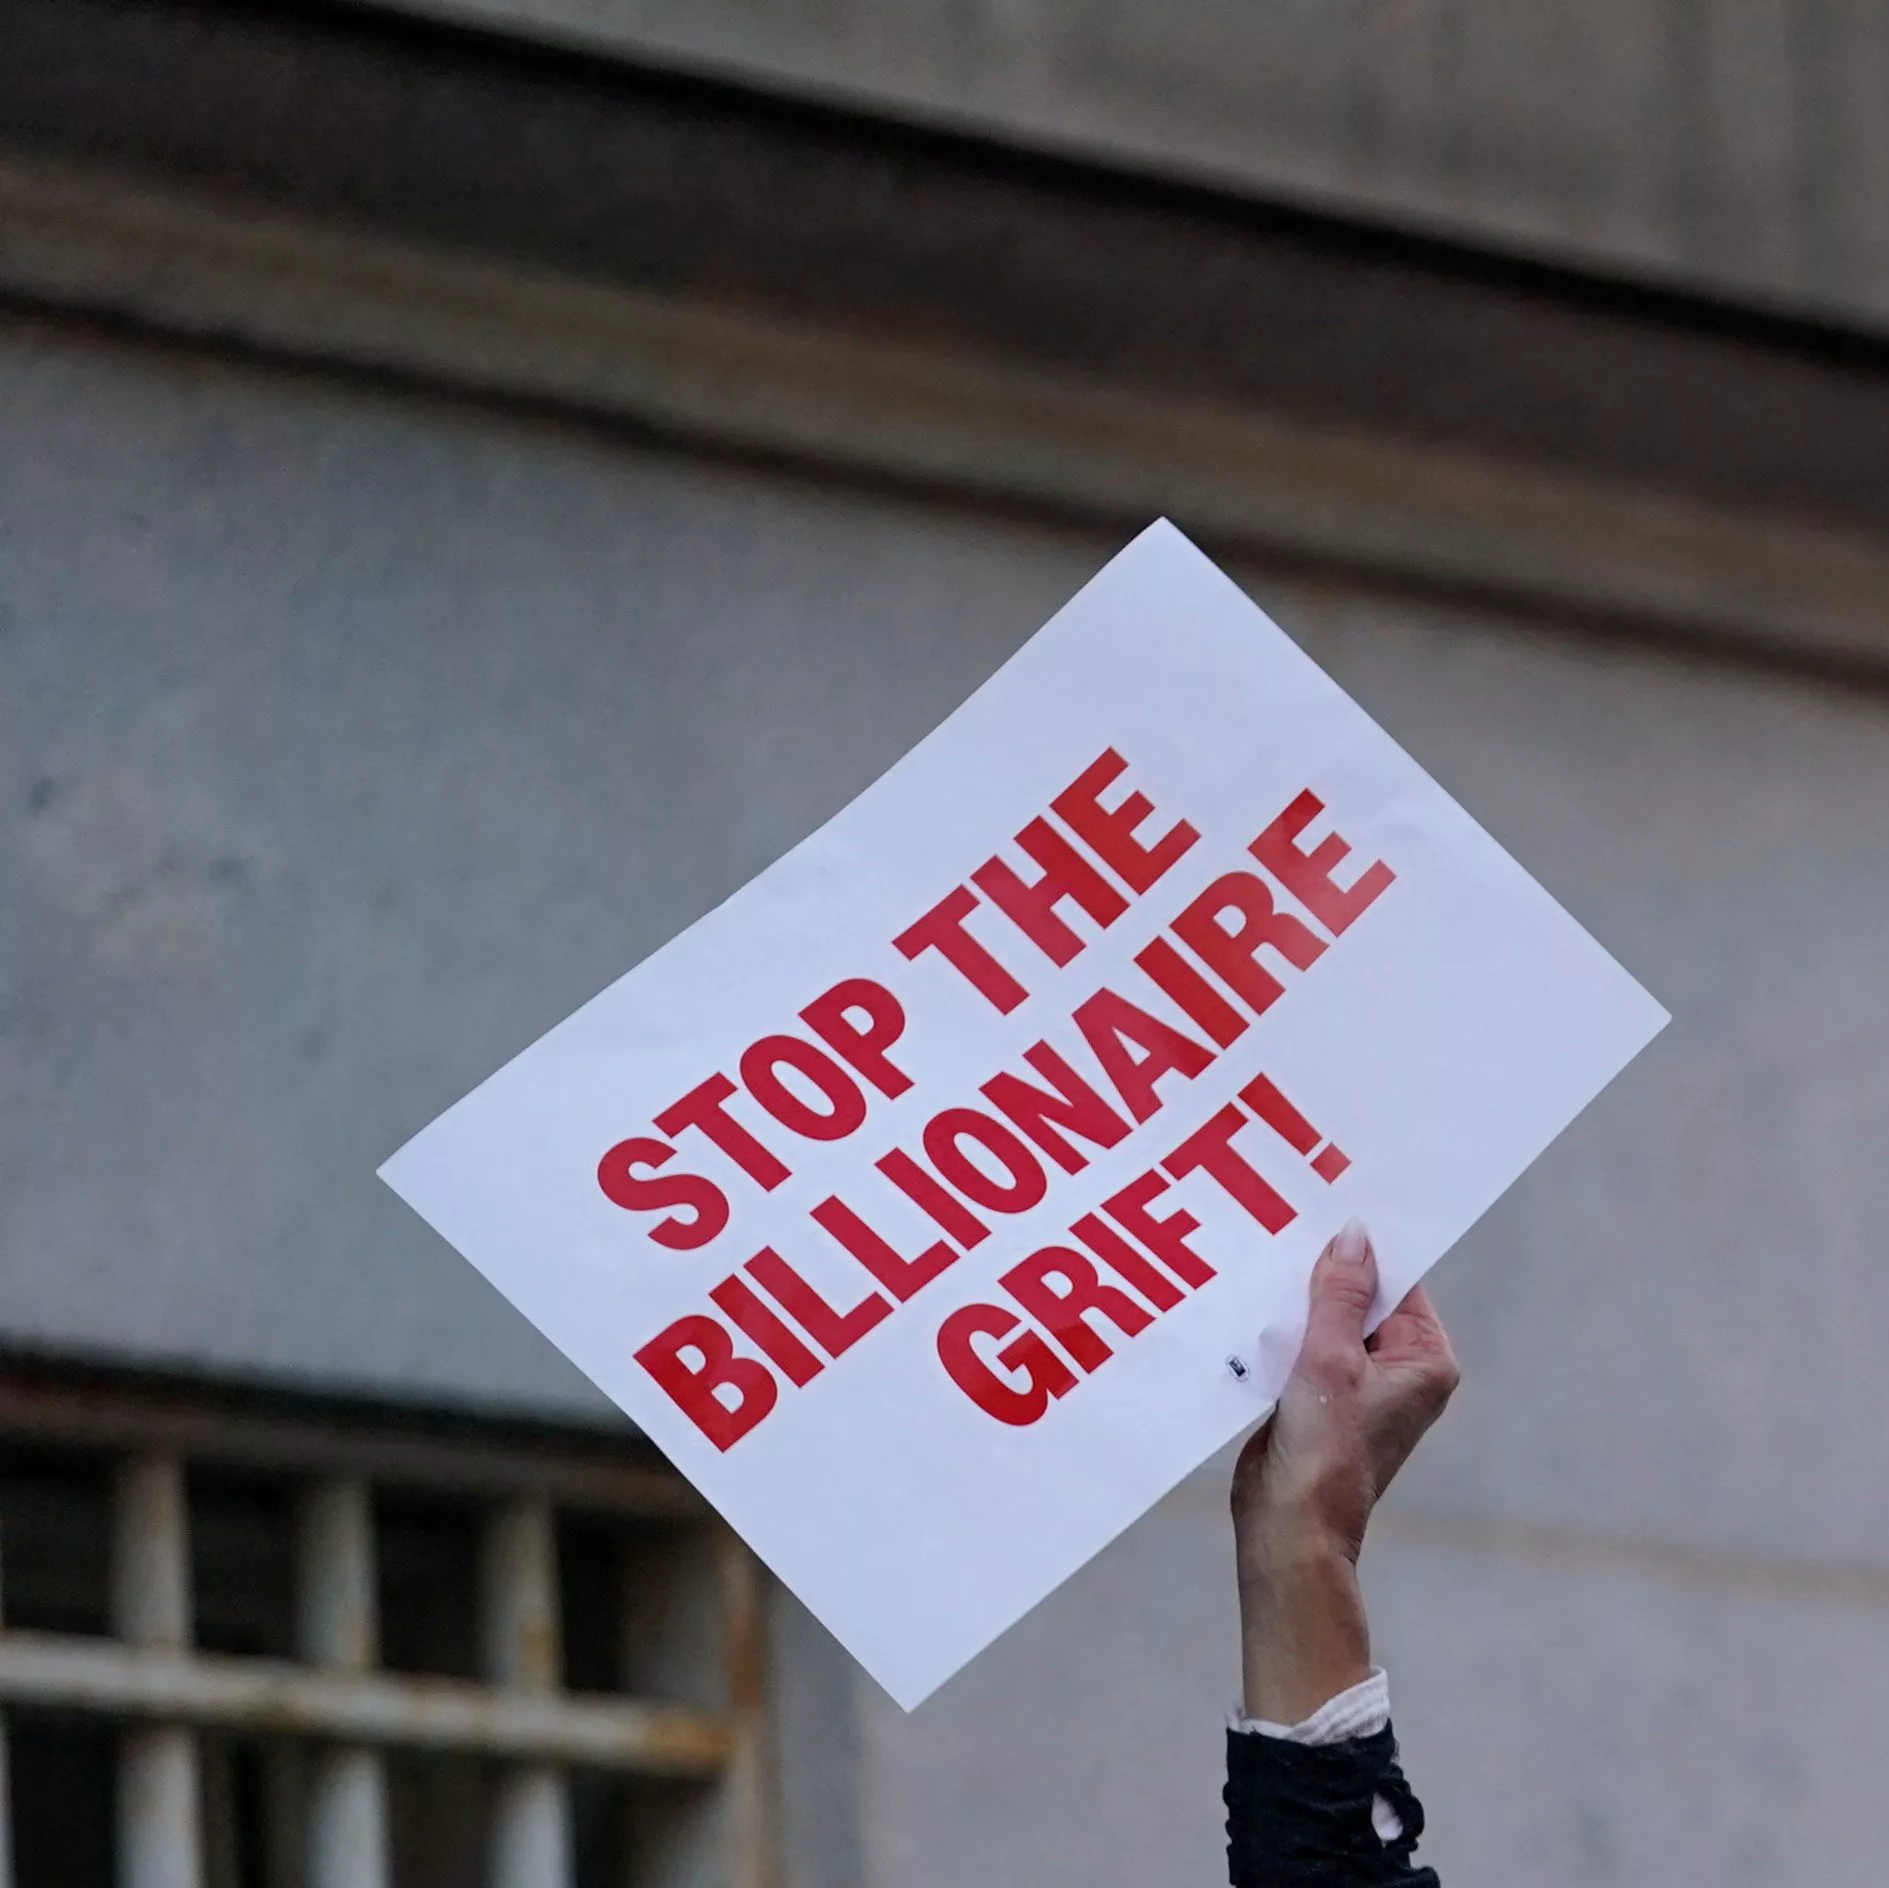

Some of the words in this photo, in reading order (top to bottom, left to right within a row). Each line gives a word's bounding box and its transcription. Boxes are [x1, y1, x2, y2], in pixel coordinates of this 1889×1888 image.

[597, 977, 915, 1251] STOP
[891, 746, 1203, 1016] THE
[633, 787, 1398, 1454] BILLIONAIRE
[936, 1072, 1353, 1427] GRIFT!
